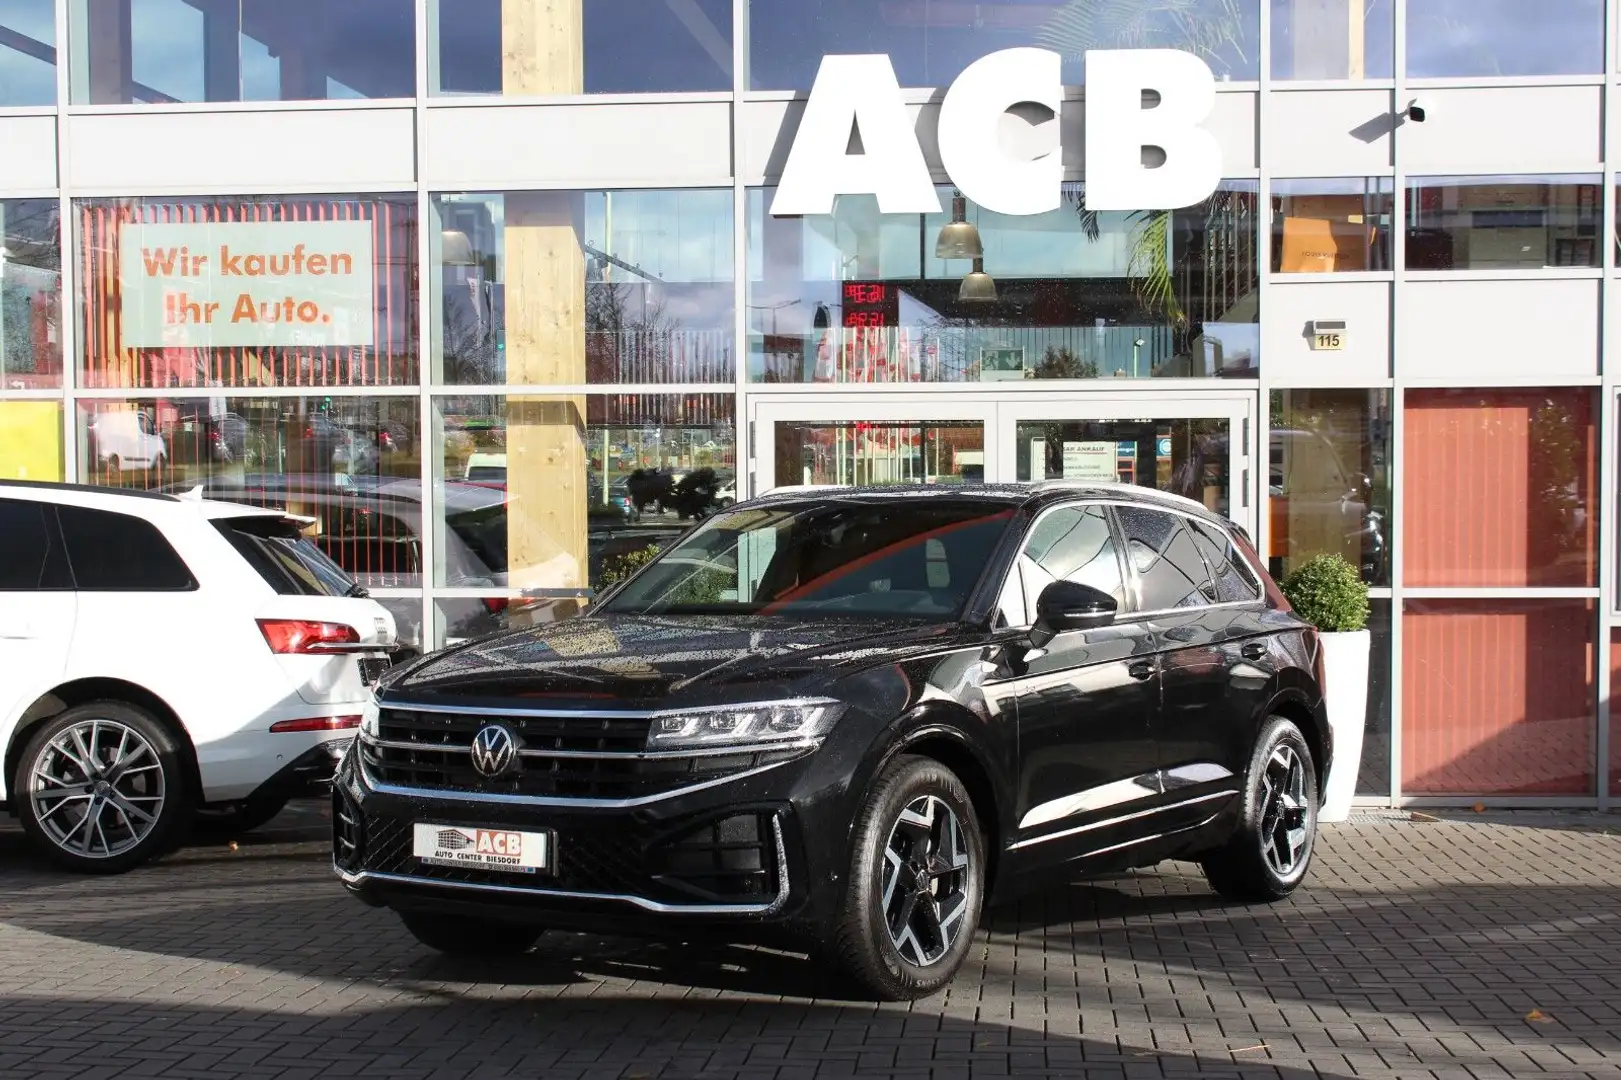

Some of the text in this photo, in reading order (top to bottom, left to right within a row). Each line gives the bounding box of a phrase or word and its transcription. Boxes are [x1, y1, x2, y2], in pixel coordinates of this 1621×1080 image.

[769, 47, 1223, 216] ACB
[141, 244, 353, 277] Wir kaufen
[166, 293, 331, 324] Ihr Auto.
[1318, 334, 1340, 347] 115
[477, 831, 521, 855] ACB
[435, 850, 521, 865] AUTO CENTER BIESDORF
